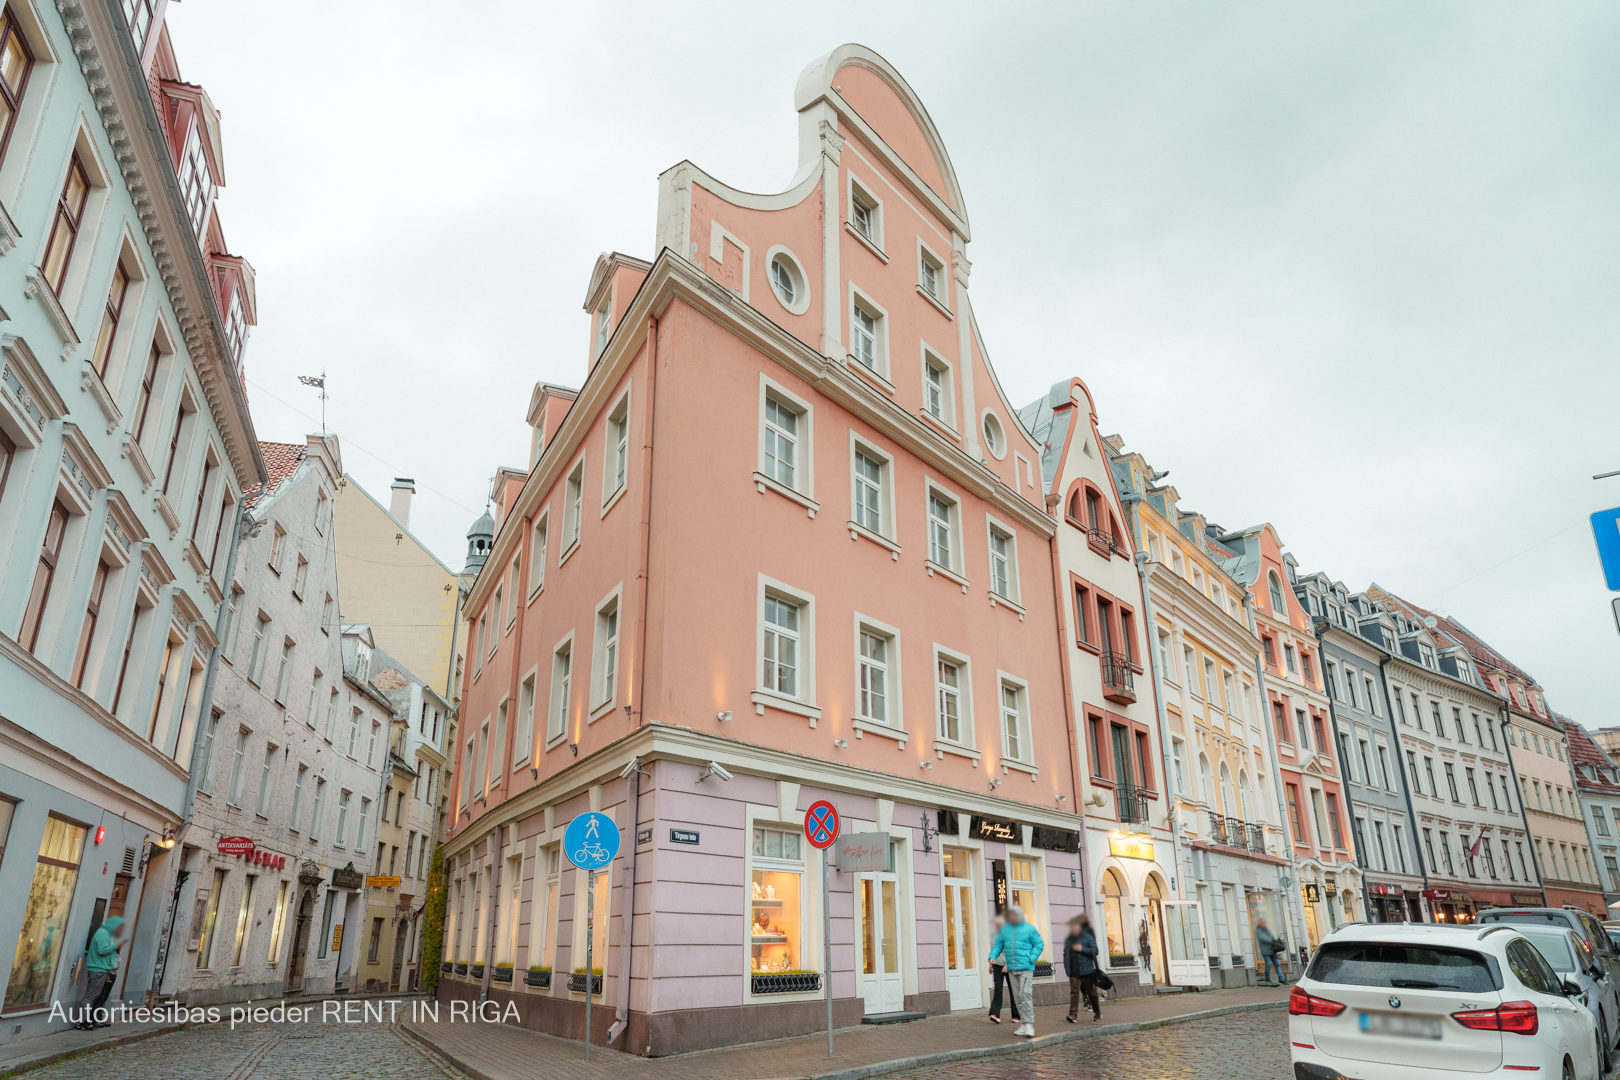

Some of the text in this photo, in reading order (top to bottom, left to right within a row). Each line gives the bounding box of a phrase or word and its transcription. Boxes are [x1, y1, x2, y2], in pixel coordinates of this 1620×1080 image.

[218, 841, 254, 849] ANTIKVARIĀTS
[237, 849, 286, 870] OLMAR
[1459, 1002, 1478, 1010] X1
